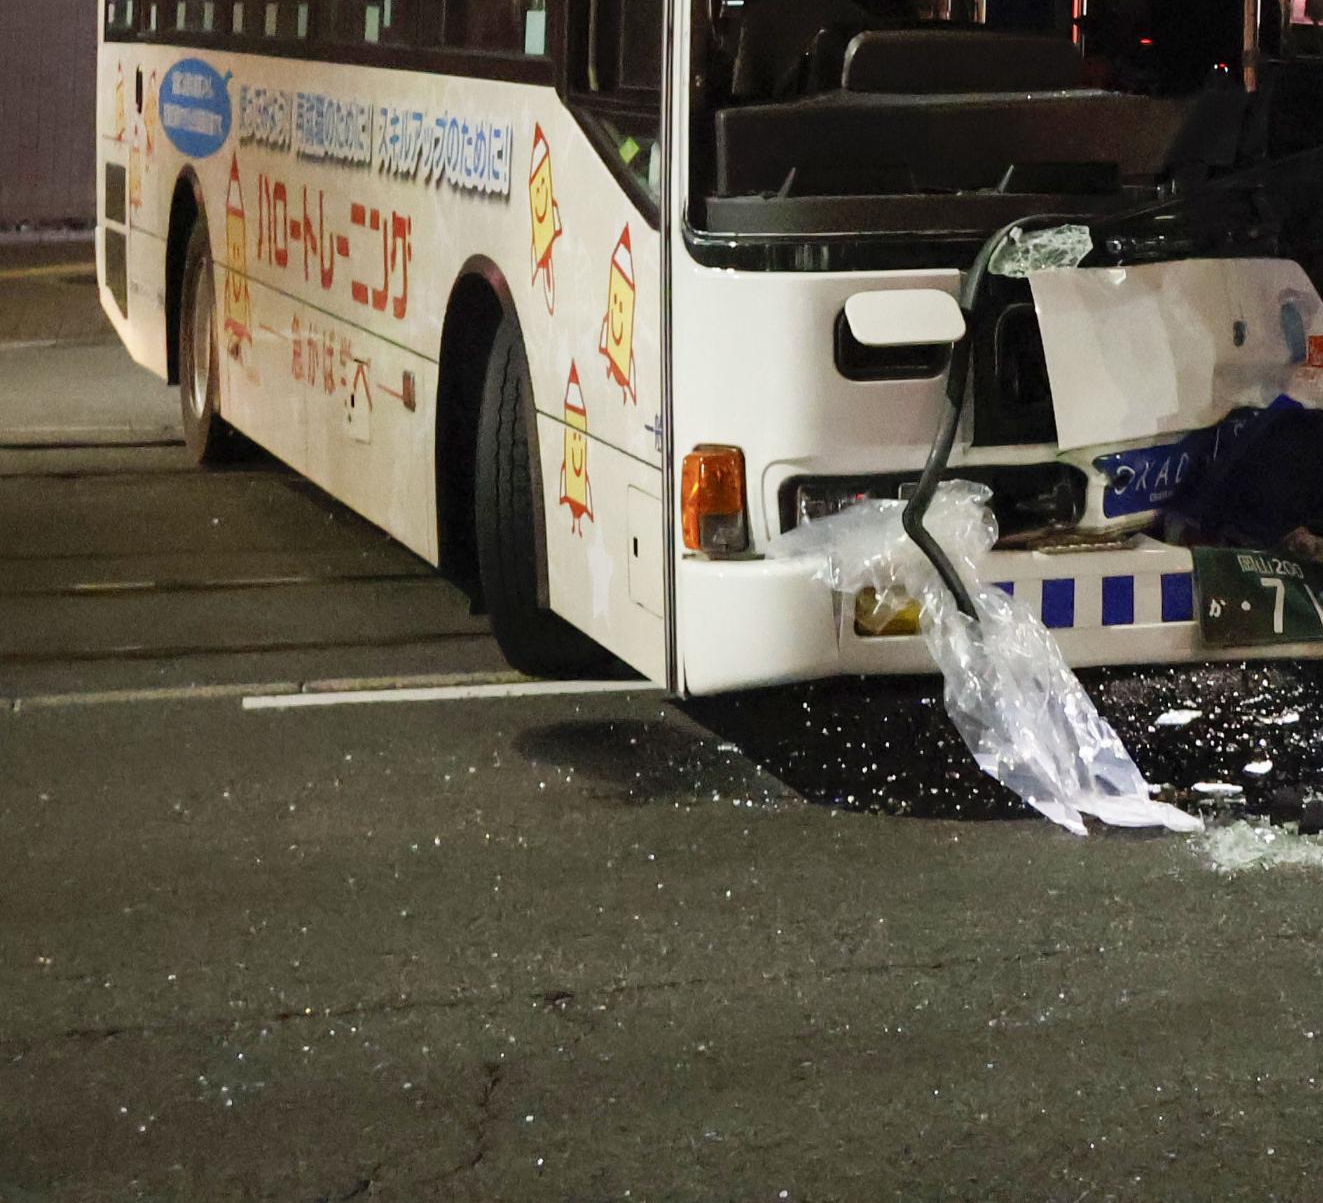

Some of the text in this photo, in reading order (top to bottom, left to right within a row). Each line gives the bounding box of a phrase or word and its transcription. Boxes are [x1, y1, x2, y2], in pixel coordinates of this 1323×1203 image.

[257, 173, 412, 320] ハロートレーニング
